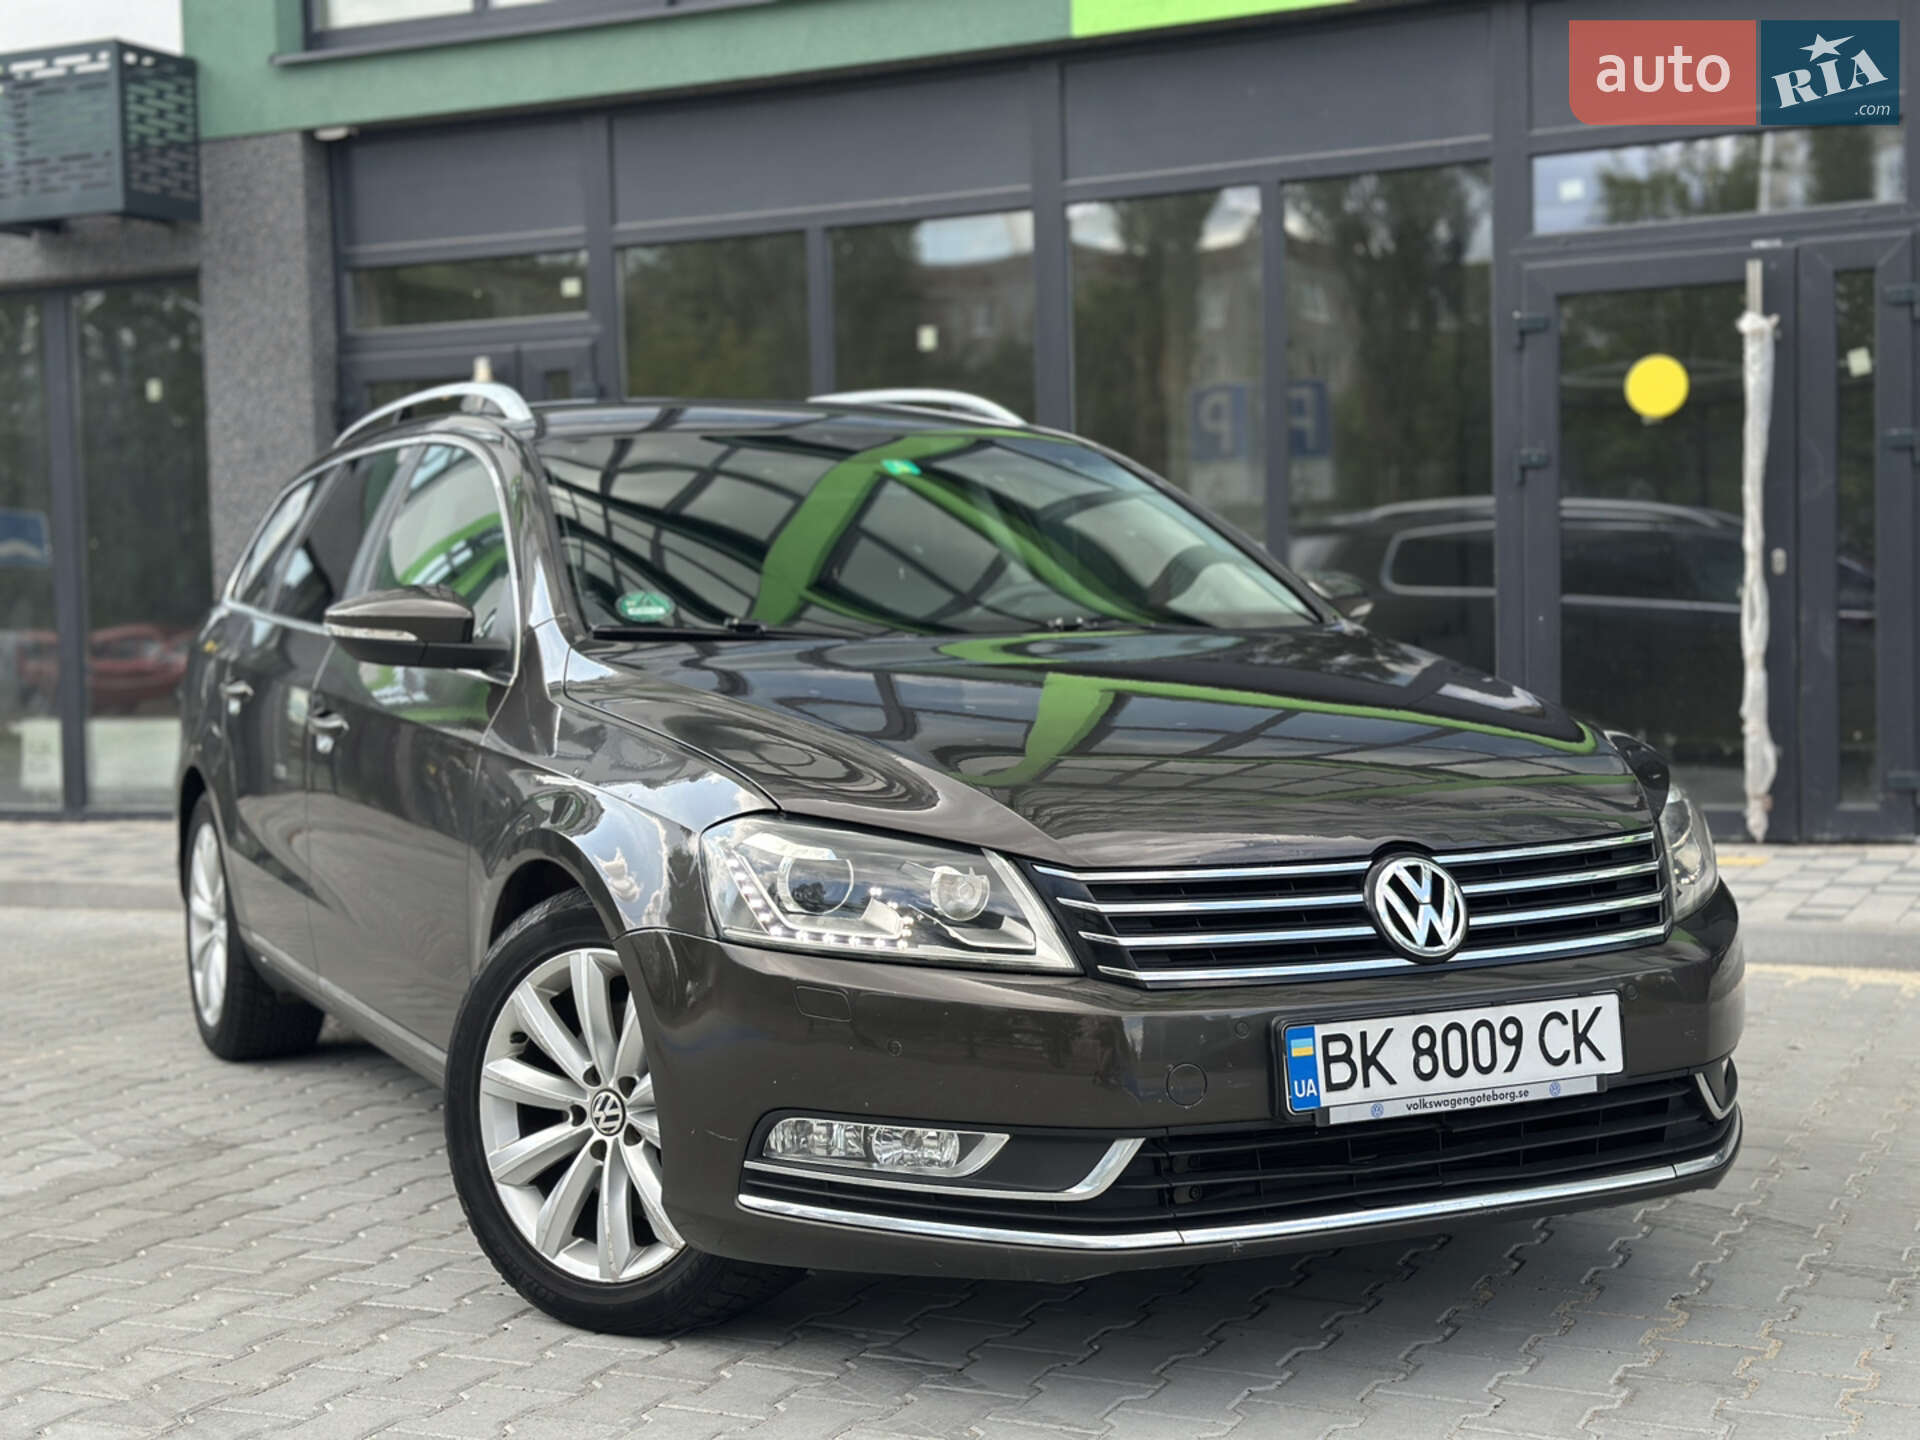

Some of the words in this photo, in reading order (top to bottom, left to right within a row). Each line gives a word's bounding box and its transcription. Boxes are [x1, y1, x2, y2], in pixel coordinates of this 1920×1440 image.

[1321, 1027, 1398, 1093] BK
[1412, 1015, 1523, 1082] 8009
[1538, 1006, 1607, 1066] CK
[1294, 1079, 1318, 1098] UA
[1406, 1088, 1529, 1111] volkswagengoteborg.se
